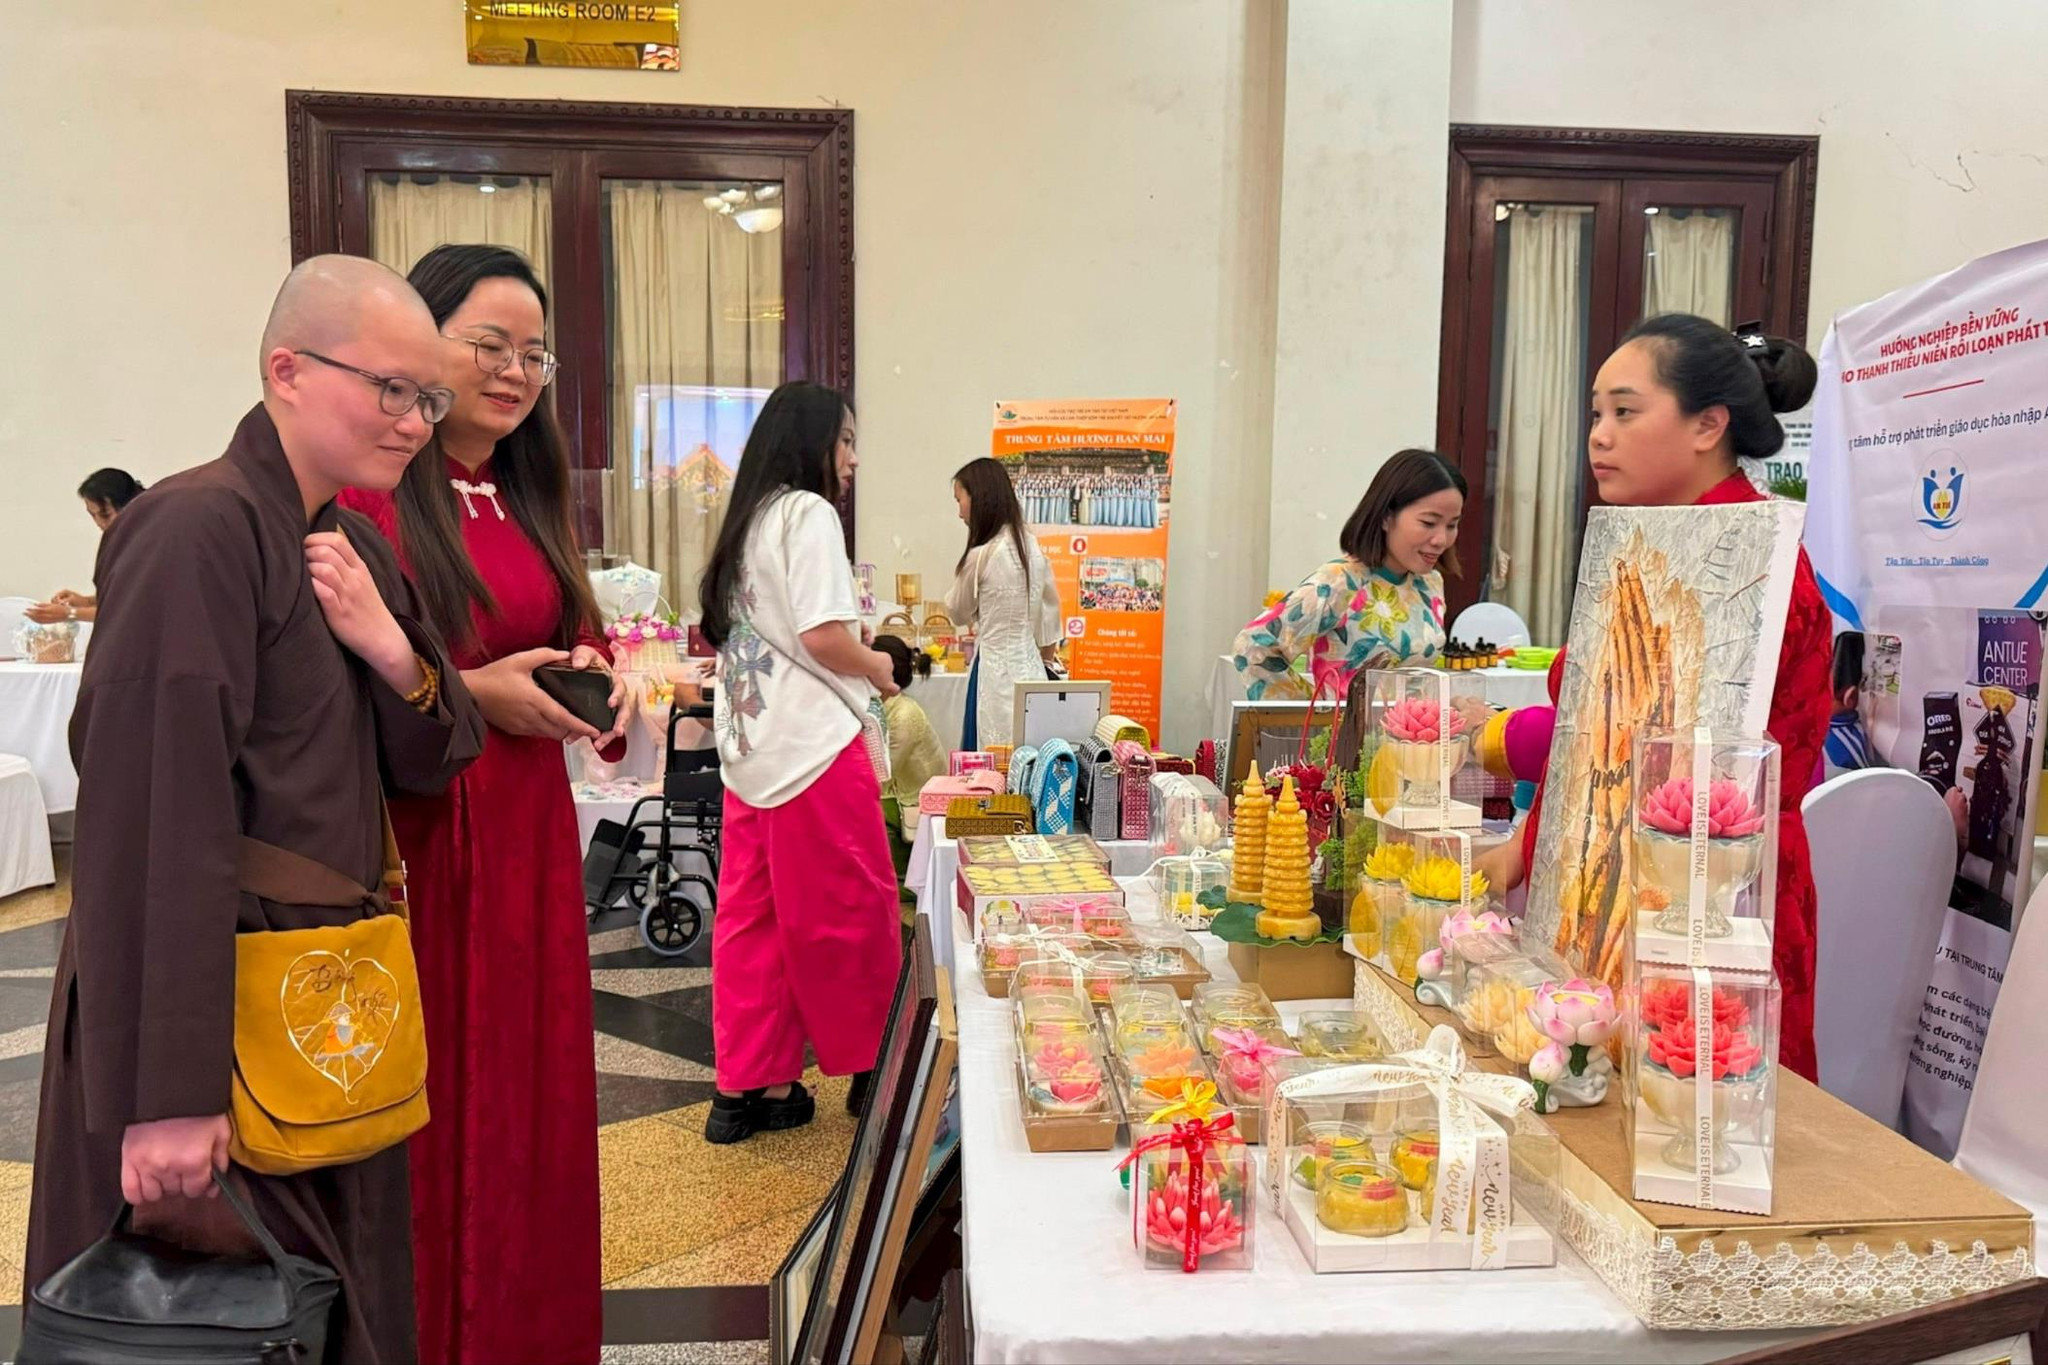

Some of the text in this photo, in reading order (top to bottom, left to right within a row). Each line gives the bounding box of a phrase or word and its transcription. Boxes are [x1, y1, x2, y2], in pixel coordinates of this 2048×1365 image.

[490, 0, 656, 22] MEETING ROOM E2
[1857, 362, 1890, 381] THANH
[1921, 343, 1948, 365] NIÊN
[1971, 332, 2005, 355] LOẠN
[2006, 318, 2041, 345] PHÁT
[1903, 425, 1925, 443] phát
[1970, 416, 1990, 433] dục
[2013, 406, 2042, 426] nhập
[1983, 640, 2029, 664] ANTUE
[1983, 666, 2028, 687] CENTER
[1960, 954, 1987, 975] TRUNG
[1941, 989, 1963, 1003] các
